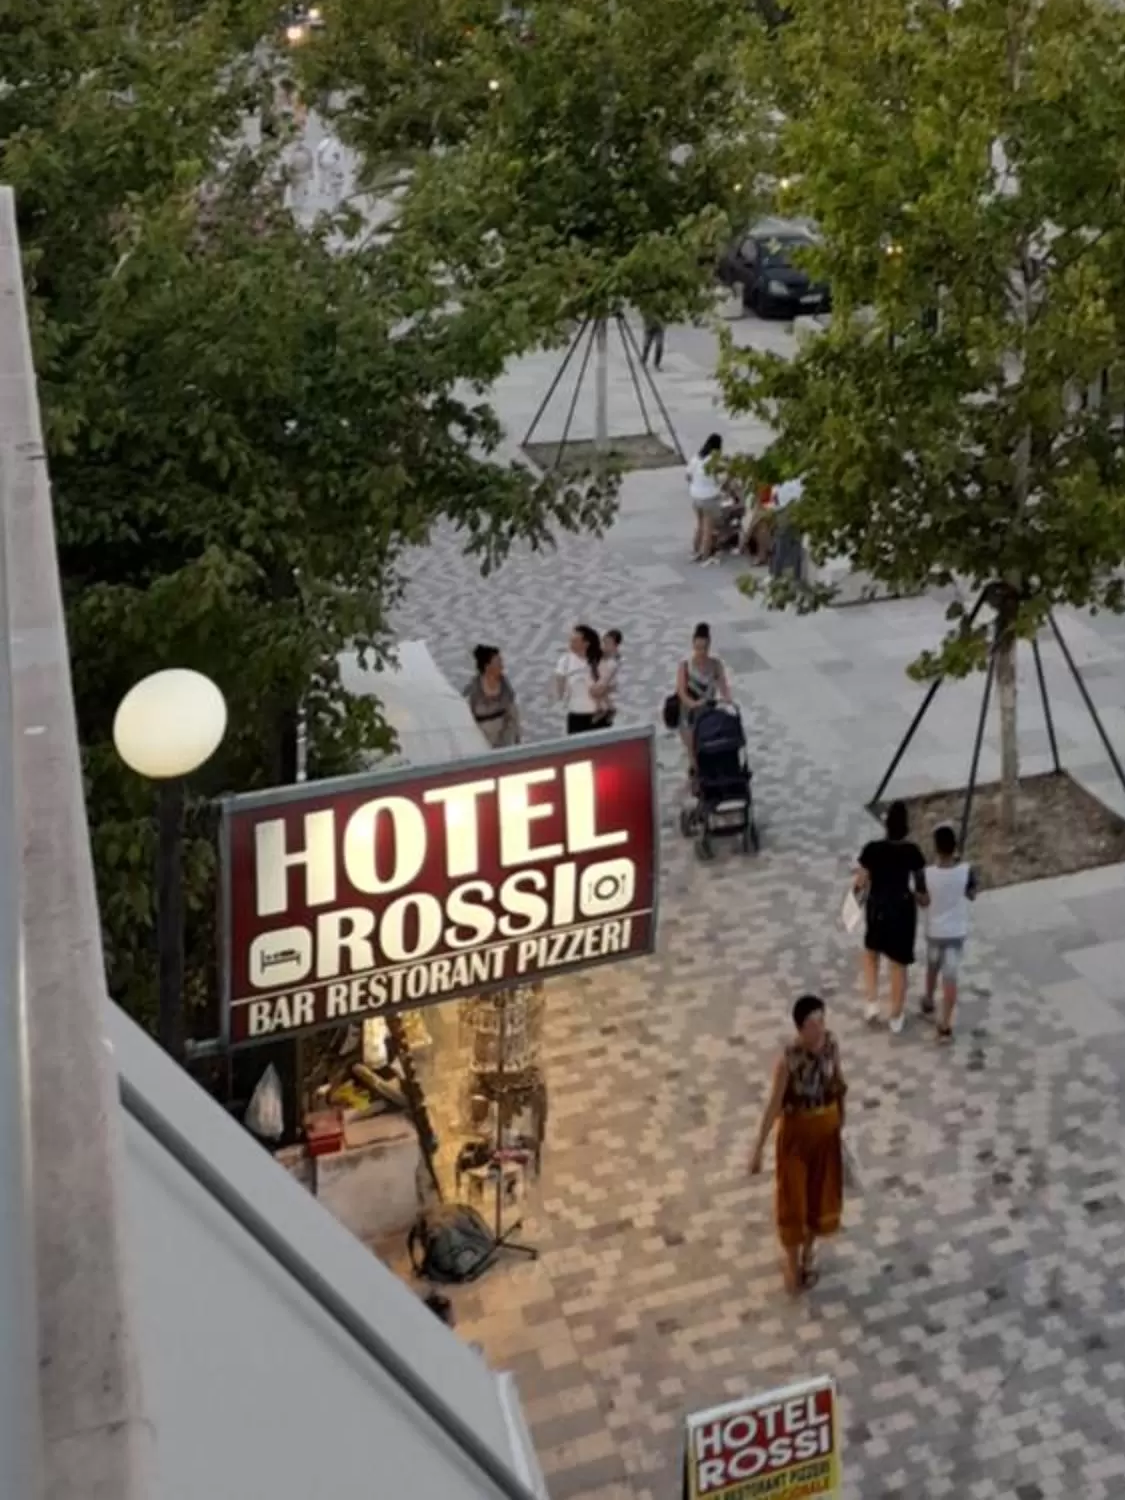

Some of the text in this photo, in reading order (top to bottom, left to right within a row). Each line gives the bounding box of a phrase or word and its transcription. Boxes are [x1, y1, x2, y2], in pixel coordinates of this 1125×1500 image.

[255, 761, 628, 916] HOTEL
[249, 918, 632, 1035] BAR RESTORANT PIZZERI
[317, 862, 575, 978] ROSSI
[696, 1395, 829, 1459] HOTEL
[699, 1425, 830, 1491] ROSSI
